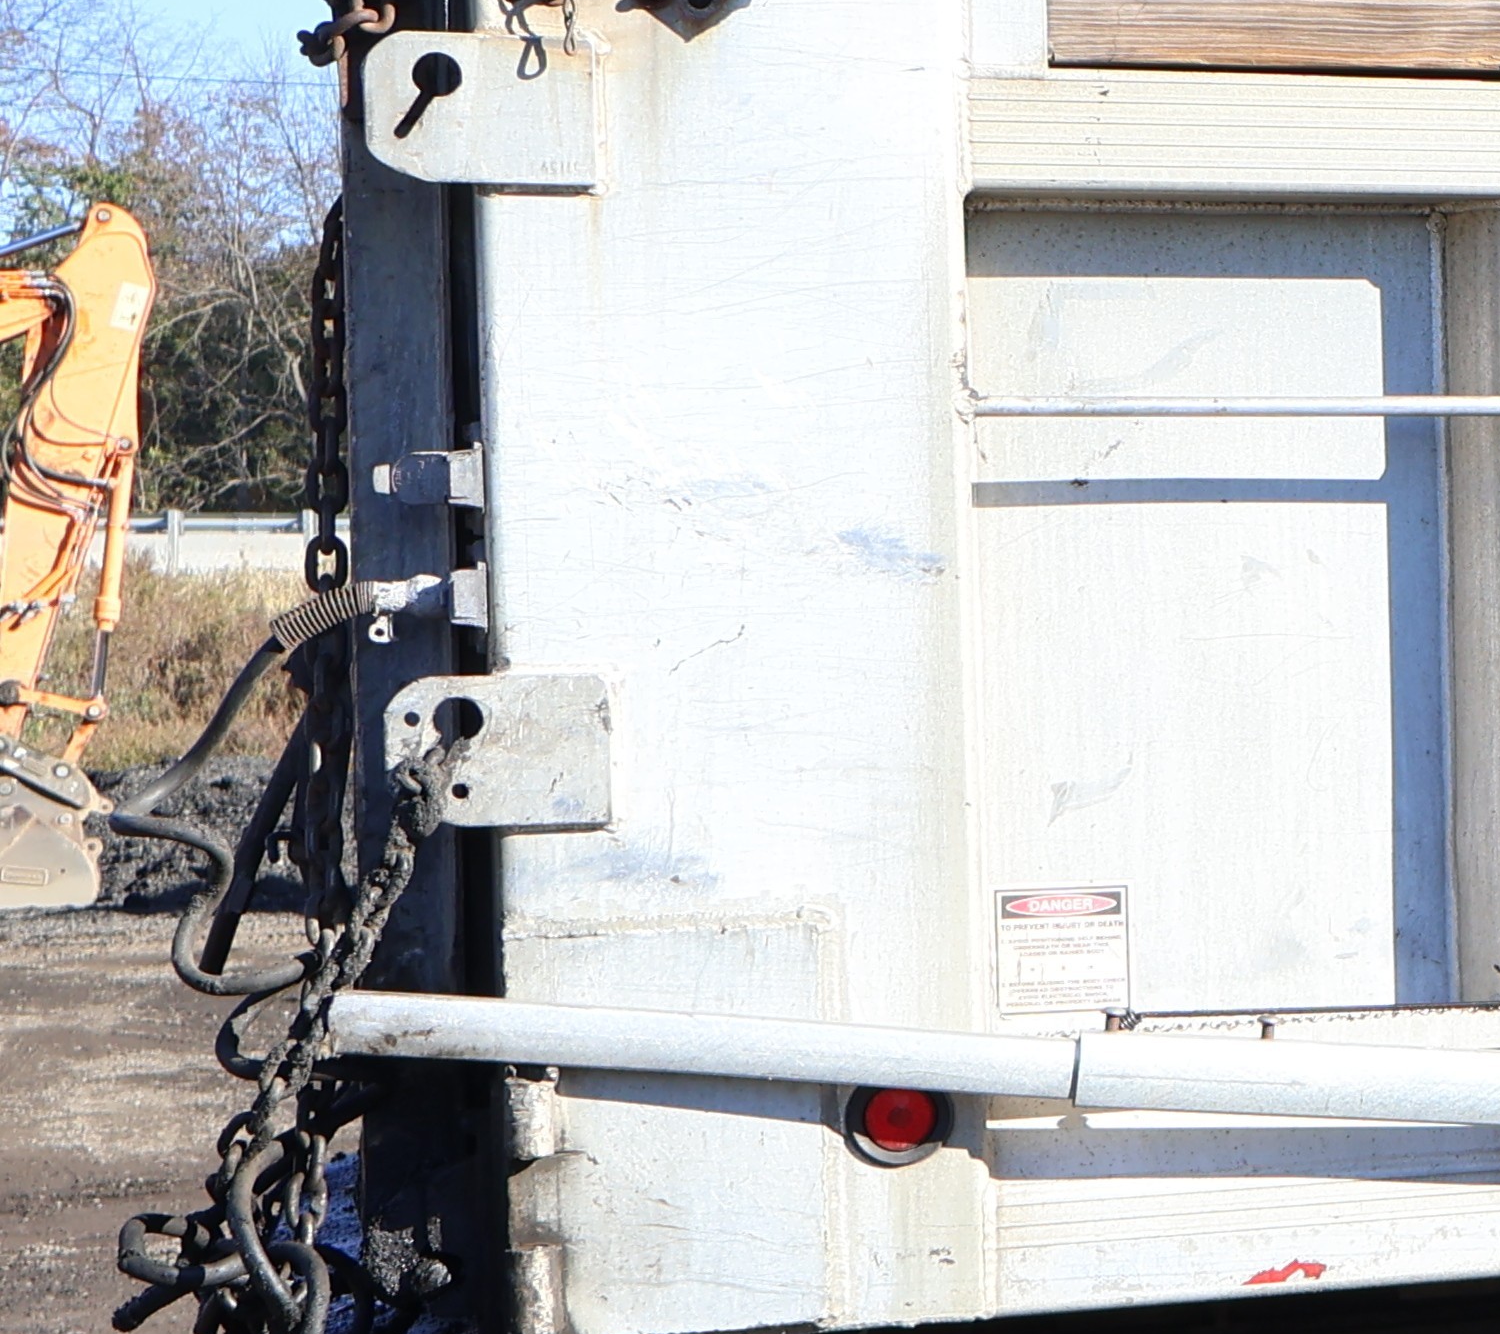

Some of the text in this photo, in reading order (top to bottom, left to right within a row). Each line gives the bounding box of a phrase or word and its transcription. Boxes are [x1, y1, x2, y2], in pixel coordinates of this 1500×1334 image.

[1028, 897, 1093, 912] DANGER
[1000, 924, 1012, 932] TO
[1013, 922, 1049, 931] PREVENT
[1098, 920, 1124, 928] DEATH
